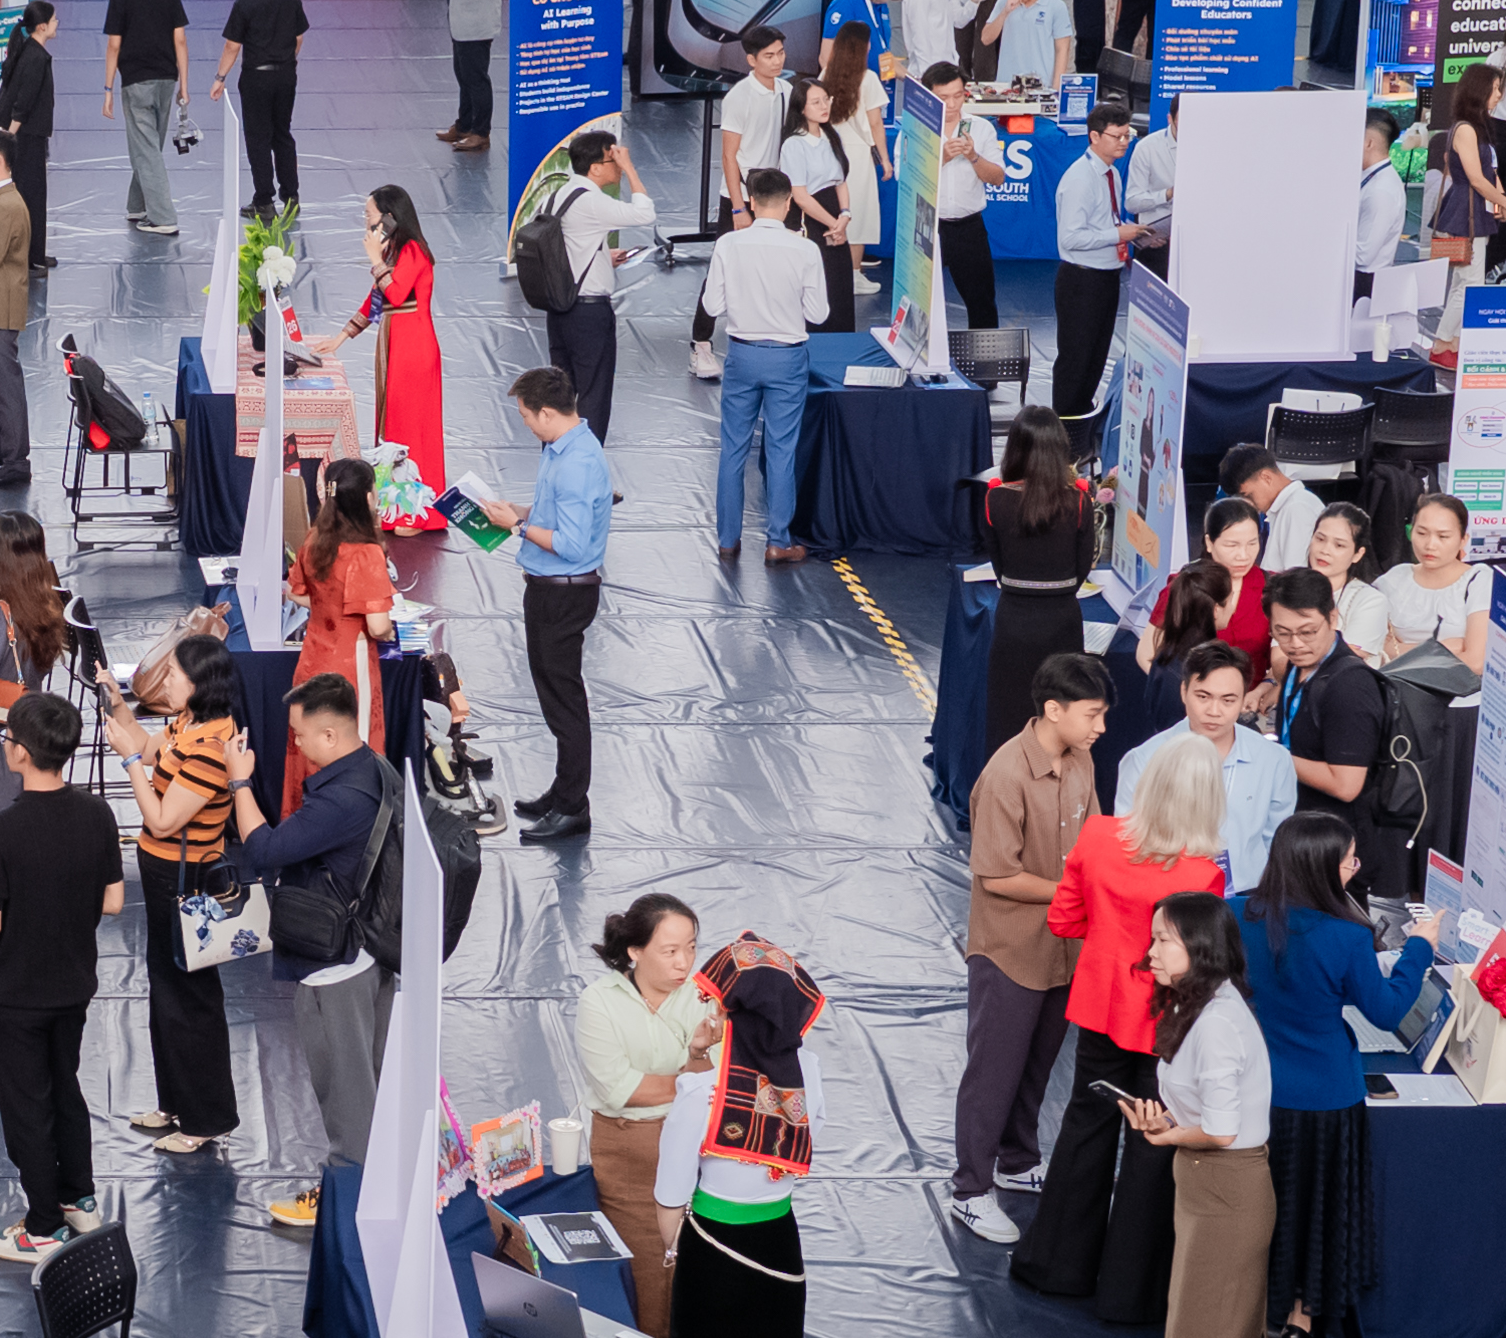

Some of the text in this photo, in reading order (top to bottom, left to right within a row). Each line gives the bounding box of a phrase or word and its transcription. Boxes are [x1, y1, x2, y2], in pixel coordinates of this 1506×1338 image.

[543, 5, 592, 18] AI Learning
[1201, 10, 1252, 19] Educators
[541, 17, 594, 30] with Purpose
[1474, 514, 1500, 525] ỨNG
